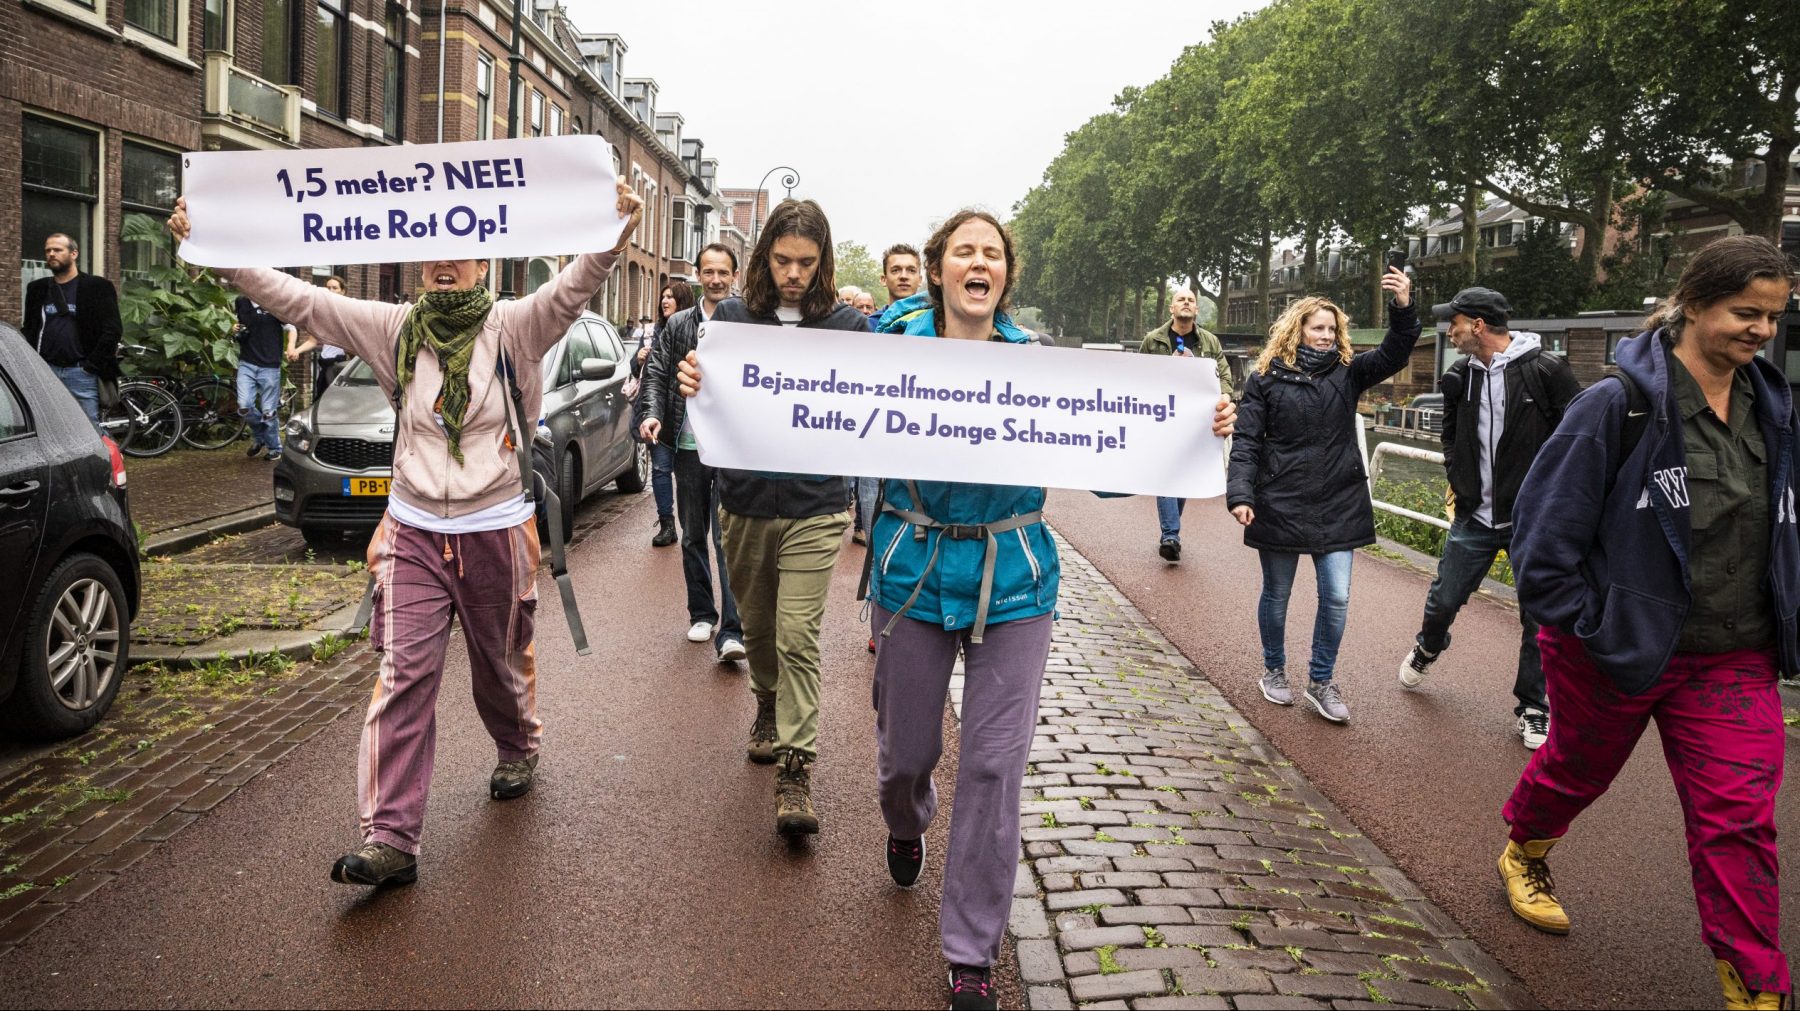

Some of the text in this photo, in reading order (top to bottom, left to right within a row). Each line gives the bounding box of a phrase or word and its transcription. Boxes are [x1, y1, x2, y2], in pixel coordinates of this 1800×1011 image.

[276, 158, 527, 203] 1,5 meter? NEE!
[303, 204, 508, 243] Rutte Rot Op!
[742, 363, 1176, 423] Bejaarden-zelfmoord door opsluiting!
[792, 403, 1126, 453] Rutte / De Jonge Schaam je!
